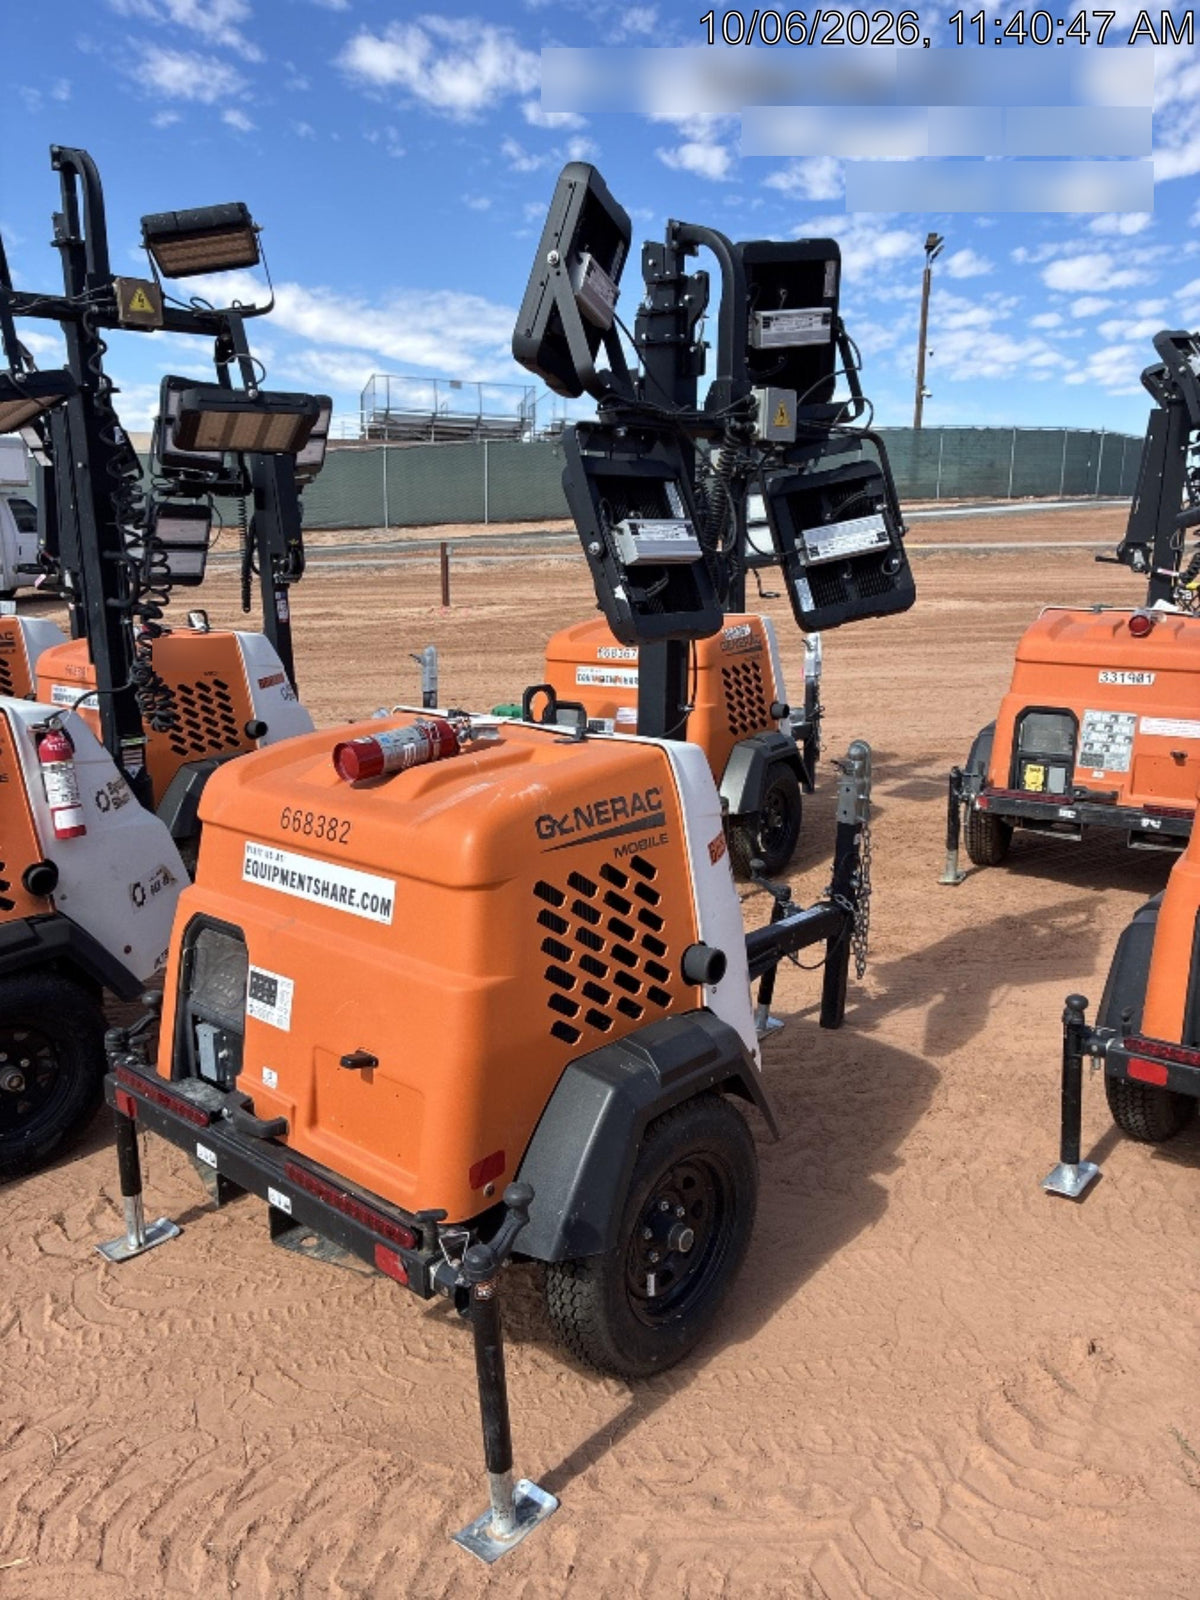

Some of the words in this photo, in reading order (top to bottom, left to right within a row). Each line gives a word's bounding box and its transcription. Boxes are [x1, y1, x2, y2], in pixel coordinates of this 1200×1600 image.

[280, 806, 351, 844] 668382
[535, 787, 663, 840] GENERAC
[614, 833, 669, 859] MOBILE
[244, 858, 392, 918] EQUIPMENTSHARE.COM
